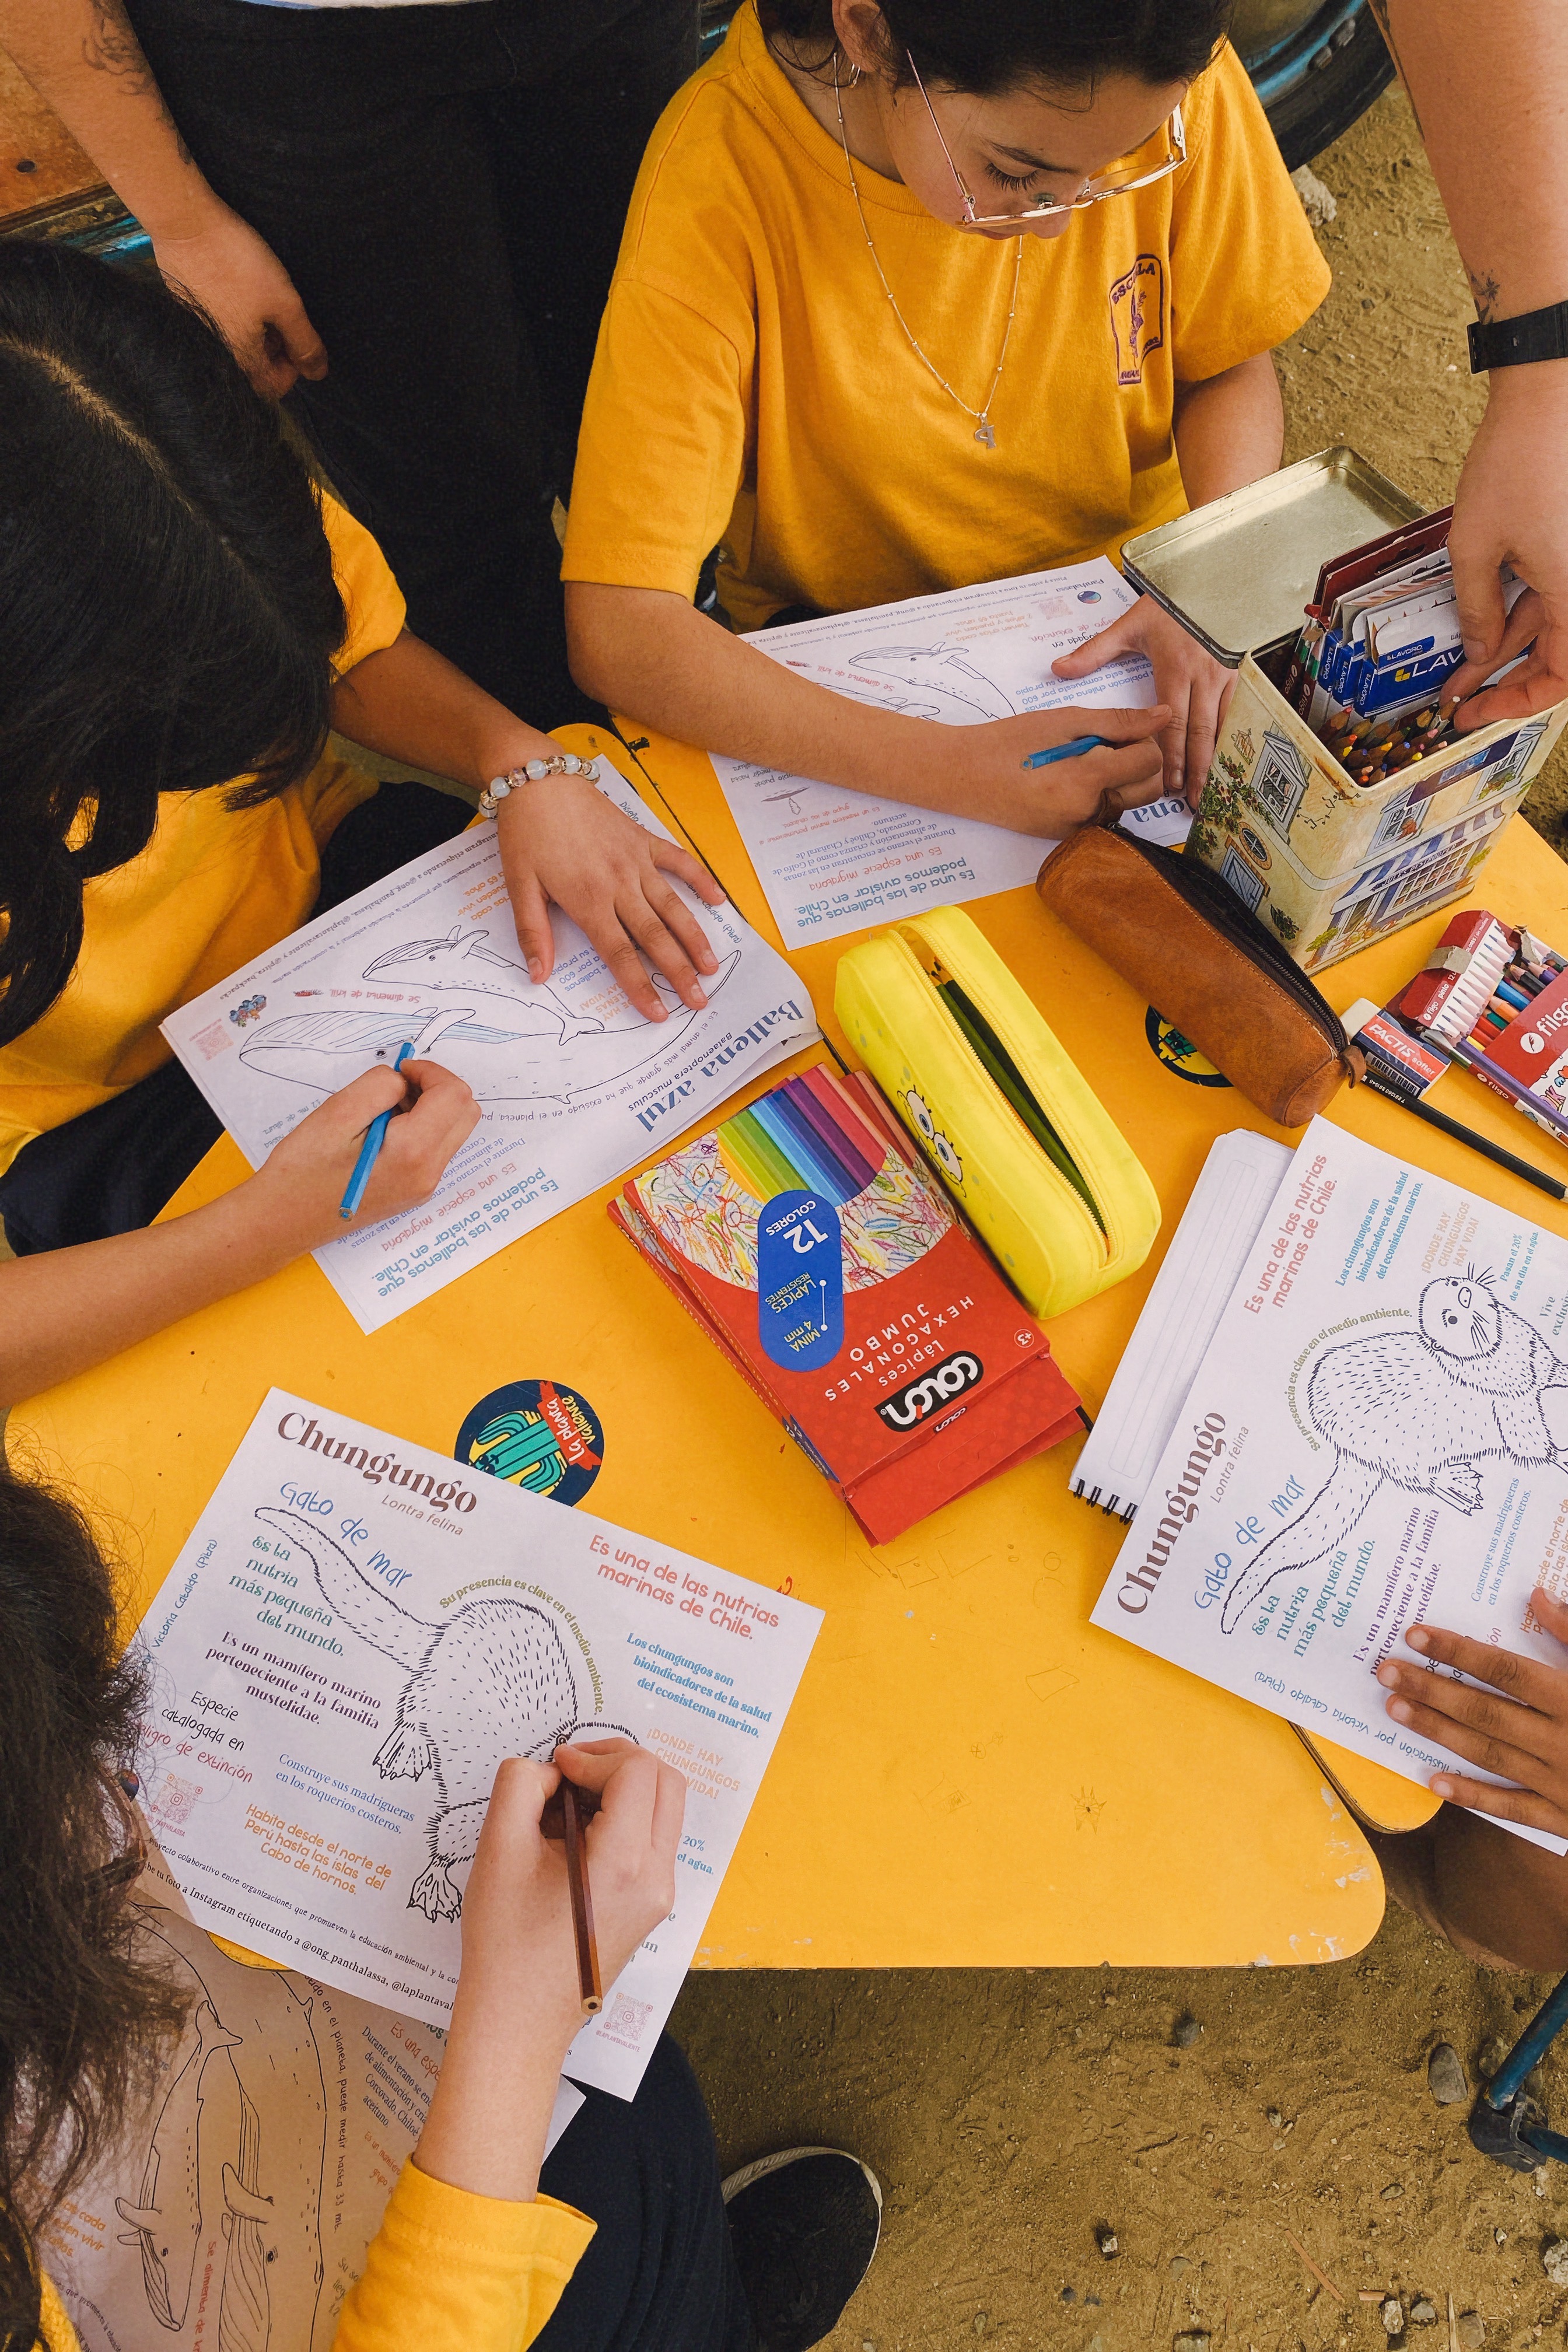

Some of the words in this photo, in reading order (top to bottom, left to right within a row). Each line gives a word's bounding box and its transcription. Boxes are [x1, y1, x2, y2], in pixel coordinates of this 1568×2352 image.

[1022, 695, 1038, 705] 600
[863, 856, 901, 875] especie
[905, 852, 924, 862] una
[928, 846, 943, 856] Es
[809, 870, 859, 890] migratoria
[905, 857, 967, 881] podemos
[930, 874, 957, 887] una
[958, 869, 976, 880] Es
[831, 894, 849, 904] en
[854, 878, 901, 898] avistar
[886, 888, 908, 900] las
[909, 883, 927, 894] de
[797, 900, 830, 915] Chile.
[797, 909, 822, 928] que
[826, 895, 885, 919] ballenas
[329, 989, 347, 998] krill.
[351, 989, 363, 999] de
[366, 991, 404, 1003] alimenta
[408, 995, 421, 1004] Se
[1426, 1001, 1439, 1016] filgo
[1437, 983, 1450, 1000] pinto
[694, 999, 804, 1077] Ballena
[1368, 1025, 1413, 1057] FACTIS
[1412, 1055, 1436, 1076] softer
[674, 1032, 740, 1080] Balaenoptera
[628, 1079, 673, 1111] musculus
[635, 1080, 695, 1133] azul
[1489, 1081, 1510, 1100] filgo
[477, 1174, 498, 1190] una
[501, 1162, 517, 1175] Es
[1294, 1154, 1327, 1210] nutrias
[482, 1167, 547, 1212] podemos
[510, 1190, 540, 1211] una
[540, 1179, 559, 1192] Es
[1309, 1180, 1338, 1215] Chile.
[435, 1188, 475, 1217] especie
[491, 1208, 510, 1224] de
[765, 1200, 816, 1236] COLORES
[381, 1214, 433, 1251] migratoria
[433, 1210, 481, 1247] avistar
[468, 1220, 492, 1238] las
[782, 1219, 829, 1254] 12
[1279, 1212, 1301, 1236] las
[1300, 1218, 1319, 1240] de
[1437, 1200, 1470, 1268] CHUNGUNGOS
[1461, 1217, 1479, 1243] VIDA!
[407, 1236, 470, 1278] ballenas
[410, 1244, 429, 1259] en
[1271, 1238, 1289, 1259] de
[371, 1258, 410, 1282] Chile.
[377, 1275, 405, 1297] que
[1257, 1260, 1280, 1292] una
[1271, 1242, 1309, 1308] marinas
[765, 1272, 811, 1306] RESISTENTES
[771, 1279, 818, 1314] LÁPICES
[1243, 1294, 1264, 1314] Es
[784, 1326, 804, 1343] mm
[789, 1328, 822, 1352] MINA
[803, 1320, 812, 1330] 4
[849, 1303, 929, 1362] JUMBO
[824, 1296, 974, 1401] HEXAGONALES
[547, 1398, 578, 1440] planta
[278, 1412, 477, 1513] Chungungo
[1209, 1461, 1235, 1503] Lontra
[1228, 1426, 1249, 1460] felina
[381, 1494, 424, 1520] Lontra
[426, 1513, 463, 1536] felina
[1117, 1412, 1227, 1614] Chungungo
[280, 1482, 334, 1516] Gato
[340, 1517, 369, 1547] de
[368, 1549, 413, 1588] mar
[1194, 1552, 1232, 1609] Gato
[1234, 1516, 1265, 1545] de
[1267, 1474, 1306, 1518] mar
[273, 1542, 290, 1561] la
[245, 1559, 298, 1588] nutria
[589, 1534, 610, 1556] Es
[614, 1548, 650, 1573] una
[653, 1564, 678, 1584] de
[681, 1573, 709, 1598] las
[712, 1590, 779, 1628] nutrias
[1331, 1600, 1352, 1628] del
[1345, 1540, 1376, 1599] mundo.
[229, 1575, 264, 1597] más
[262, 1590, 334, 1627] pequeña
[597, 1563, 674, 1605] marinas
[679, 1597, 704, 1618] de
[709, 1608, 753, 1640] Chile.
[1260, 1595, 1280, 1614] la
[1276, 1586, 1310, 1642] nutria
[1294, 1621, 1317, 1657] más
[1311, 1549, 1348, 1624] pequeña
[257, 1609, 283, 1629] del
[284, 1623, 344, 1657] mundo.
[222, 1631, 236, 1647] Es
[242, 1643, 260, 1656] un
[262, 1652, 327, 1685] mamífero
[330, 1682, 381, 1709] marino
[626, 1632, 648, 1649] Los
[648, 1644, 713, 1678] chungungos
[713, 1672, 734, 1687] son
[205, 1648, 298, 1693] perteneciente
[300, 1688, 310, 1699] a
[313, 1691, 327, 1706] la
[330, 1699, 379, 1729] familia
[632, 1655, 713, 1698] bioindicadores
[713, 1690, 728, 1703] de
[728, 1696, 740, 1709] la
[740, 1703, 772, 1723] salud
[1254, 1671, 1286, 1694] (Pitra)
[245, 1685, 320, 1724] mustelidae.
[637, 1678, 656, 1692] del
[654, 1686, 716, 1718] ecosistema
[716, 1713, 759, 1738] marino.
[1290, 1689, 1328, 1713] Cataldo
[1332, 1708, 1368, 1735] Victoria
[276, 1772, 289, 1783] en
[289, 1774, 306, 1790] los
[306, 1786, 356, 1813] roquerios
[357, 1809, 401, 1835] costeros.
[279, 1754, 331, 1784] Construye
[331, 1779, 349, 1792] sus
[350, 1787, 415, 1822] madrigueras
[189, 1887, 236, 1916] Instagram
[237, 1912, 293, 1941] etiquetando
[302, 1941, 388, 1987] @ong_panthalassa,
[330, 2031, 346, 2074] planeta,
[336, 2078, 348, 2113] puede
[338, 2118, 347, 2148] medir
[335, 2155, 346, 2188] hasta
[335, 2193, 345, 2206] 33
